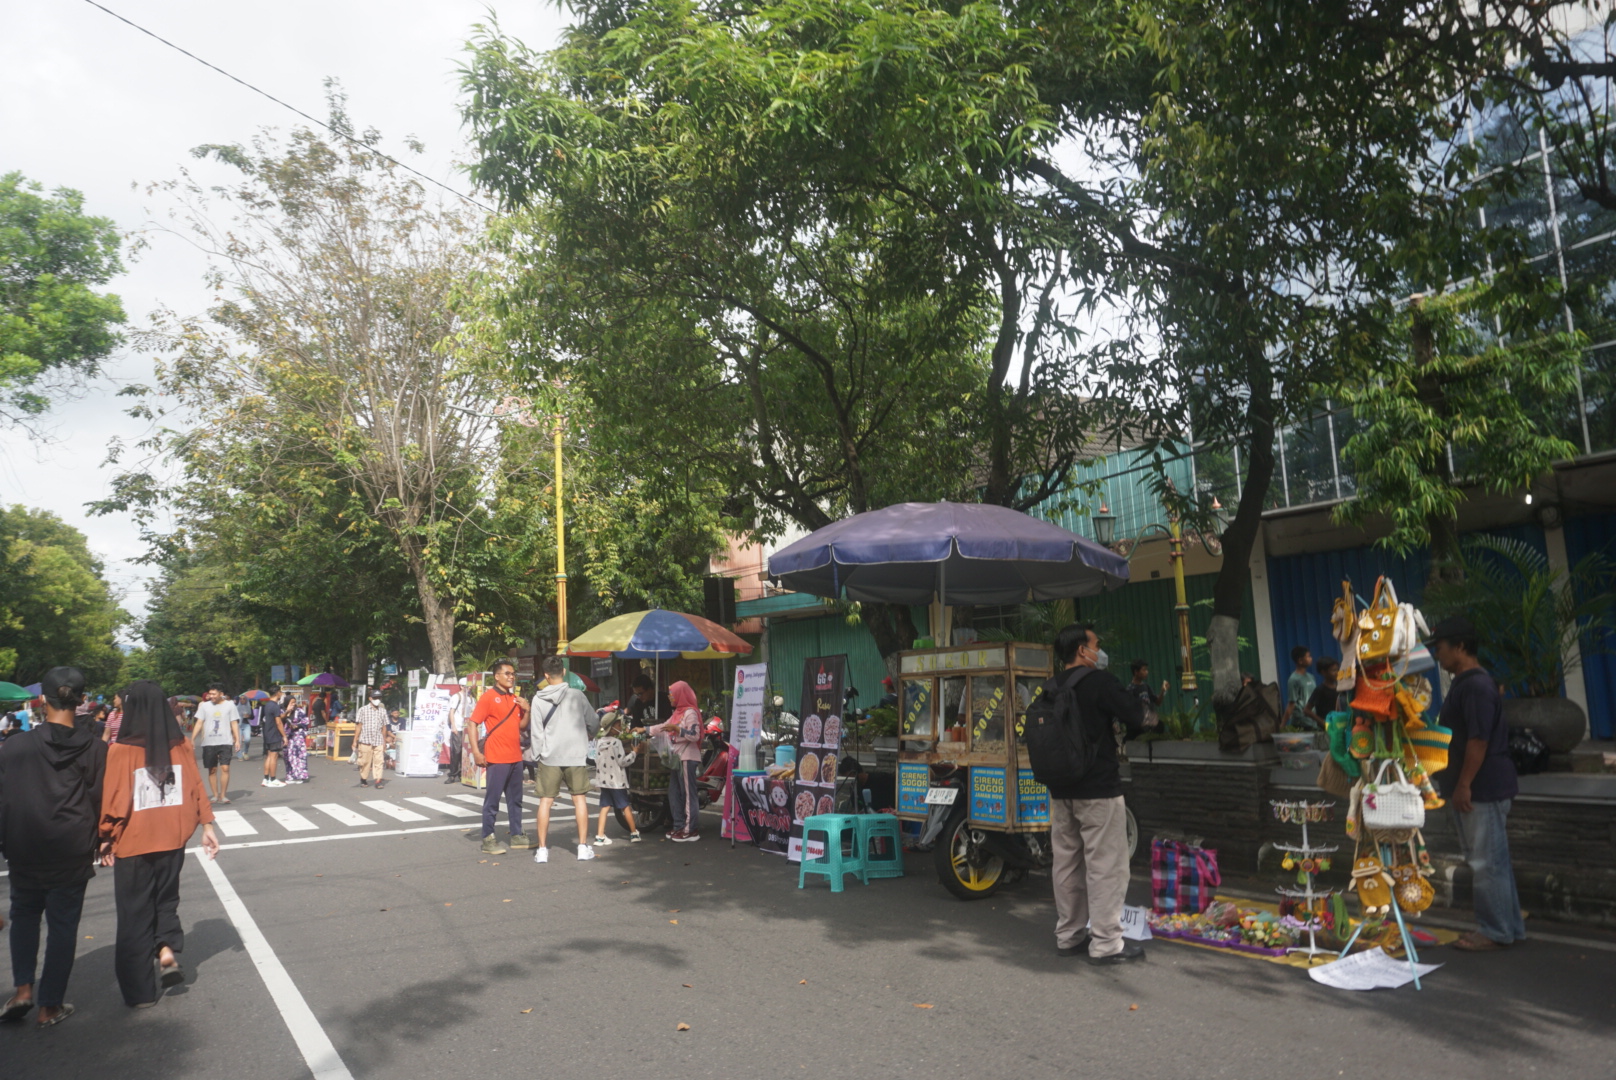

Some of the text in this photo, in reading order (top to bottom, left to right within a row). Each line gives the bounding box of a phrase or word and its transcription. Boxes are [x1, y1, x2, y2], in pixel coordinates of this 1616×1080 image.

[916, 650, 987, 672] SOGOR
[420, 702, 442, 710] LET'S
[903, 680, 932, 734] SOGOR
[420, 708, 440, 716] JOIN
[973, 687, 1004, 740] SOGOR
[901, 771, 928, 780] CIRENG
[973, 775, 1004, 786] CIRENG
[901, 778, 928, 788] SOGOR
[1018, 778, 1045, 787] CIRE
[973, 783, 1005, 794] SOGOR
[1019, 786, 1047, 795] SOGOR
